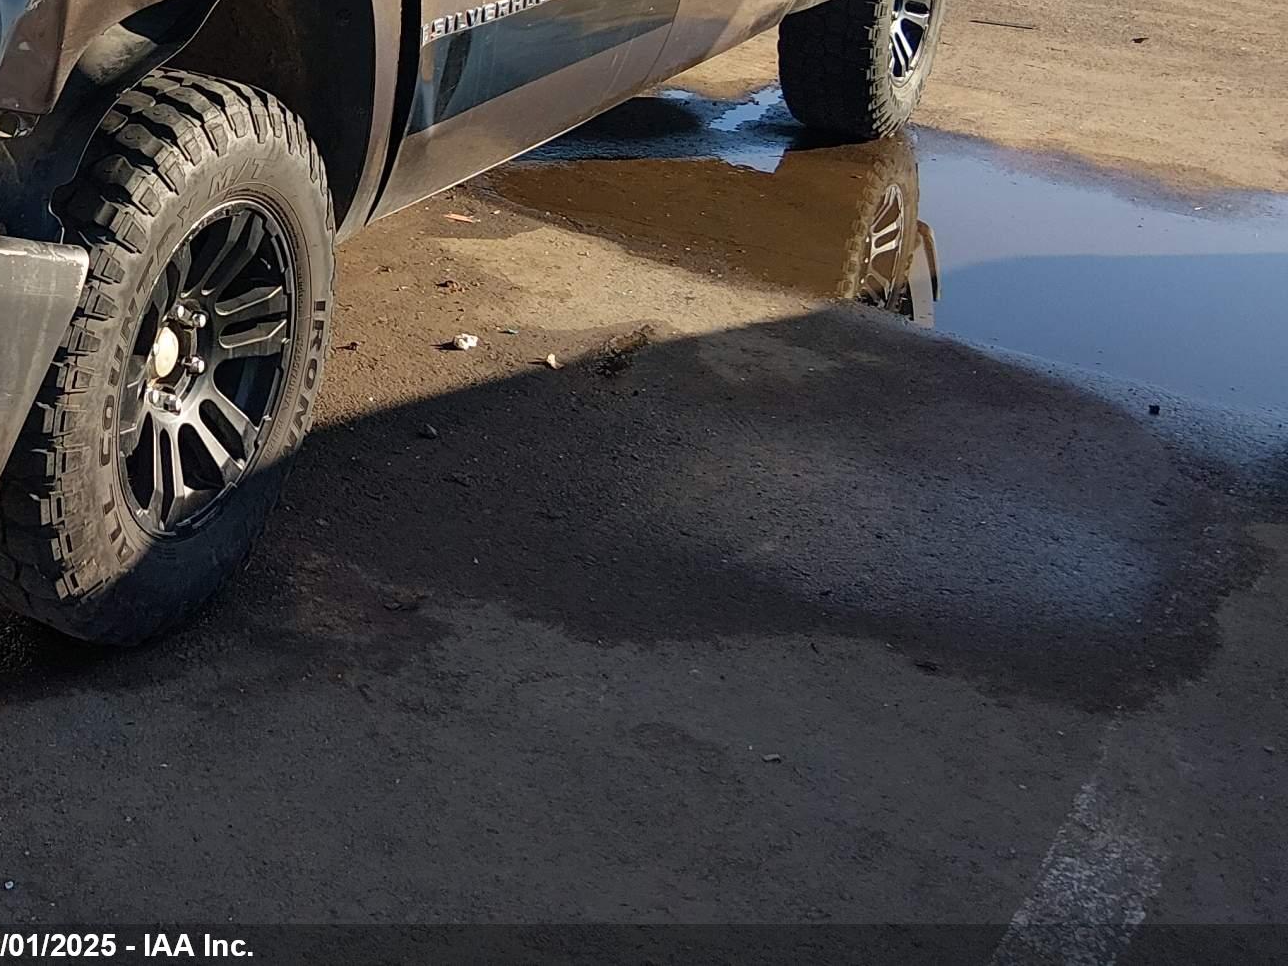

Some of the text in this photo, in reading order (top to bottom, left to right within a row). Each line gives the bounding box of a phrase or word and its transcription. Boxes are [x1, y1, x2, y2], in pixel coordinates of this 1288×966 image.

[100, 195, 196, 467] COUNTRY
[208, 158, 265, 198] M/T
[284, 298, 326, 450] IRON
